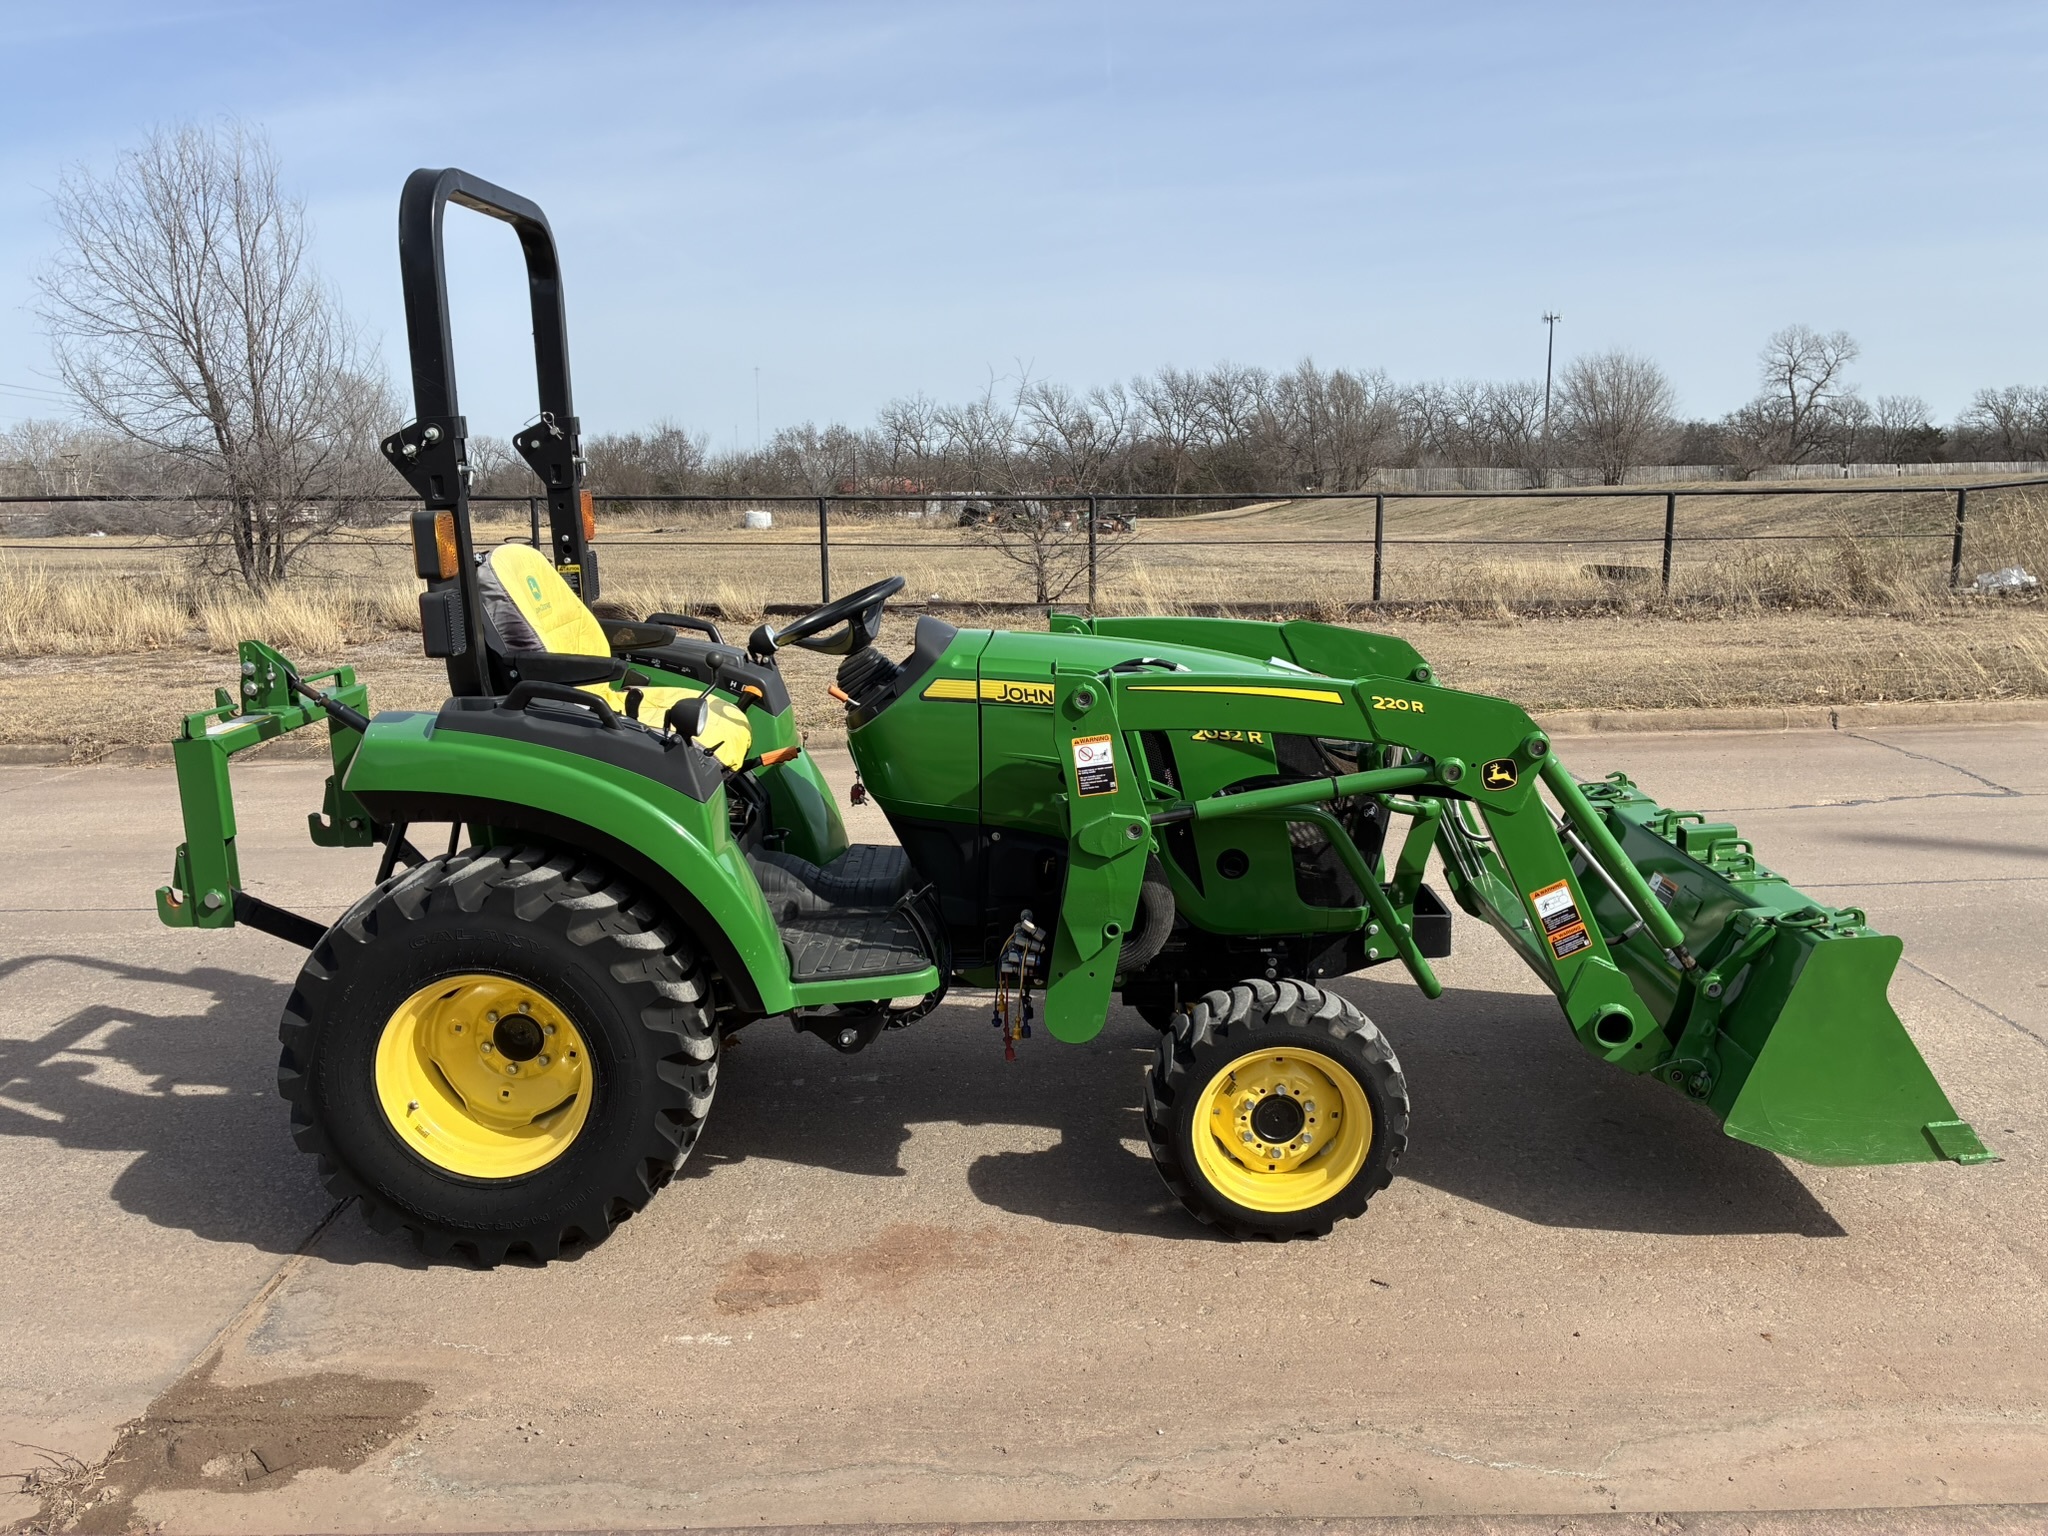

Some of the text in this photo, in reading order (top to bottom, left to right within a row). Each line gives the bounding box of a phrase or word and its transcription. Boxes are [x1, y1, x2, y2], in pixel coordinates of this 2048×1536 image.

[996, 683, 1054, 704] JOHN
[1371, 695, 1425, 713] 220 R
[1080, 734, 1110, 744] WARNING
[1191, 729, 1264, 744] 2032 R
[1540, 883, 1563, 895] WARNING
[1558, 925, 1582, 938] WARNING
[408, 927, 550, 954] GALAXY
